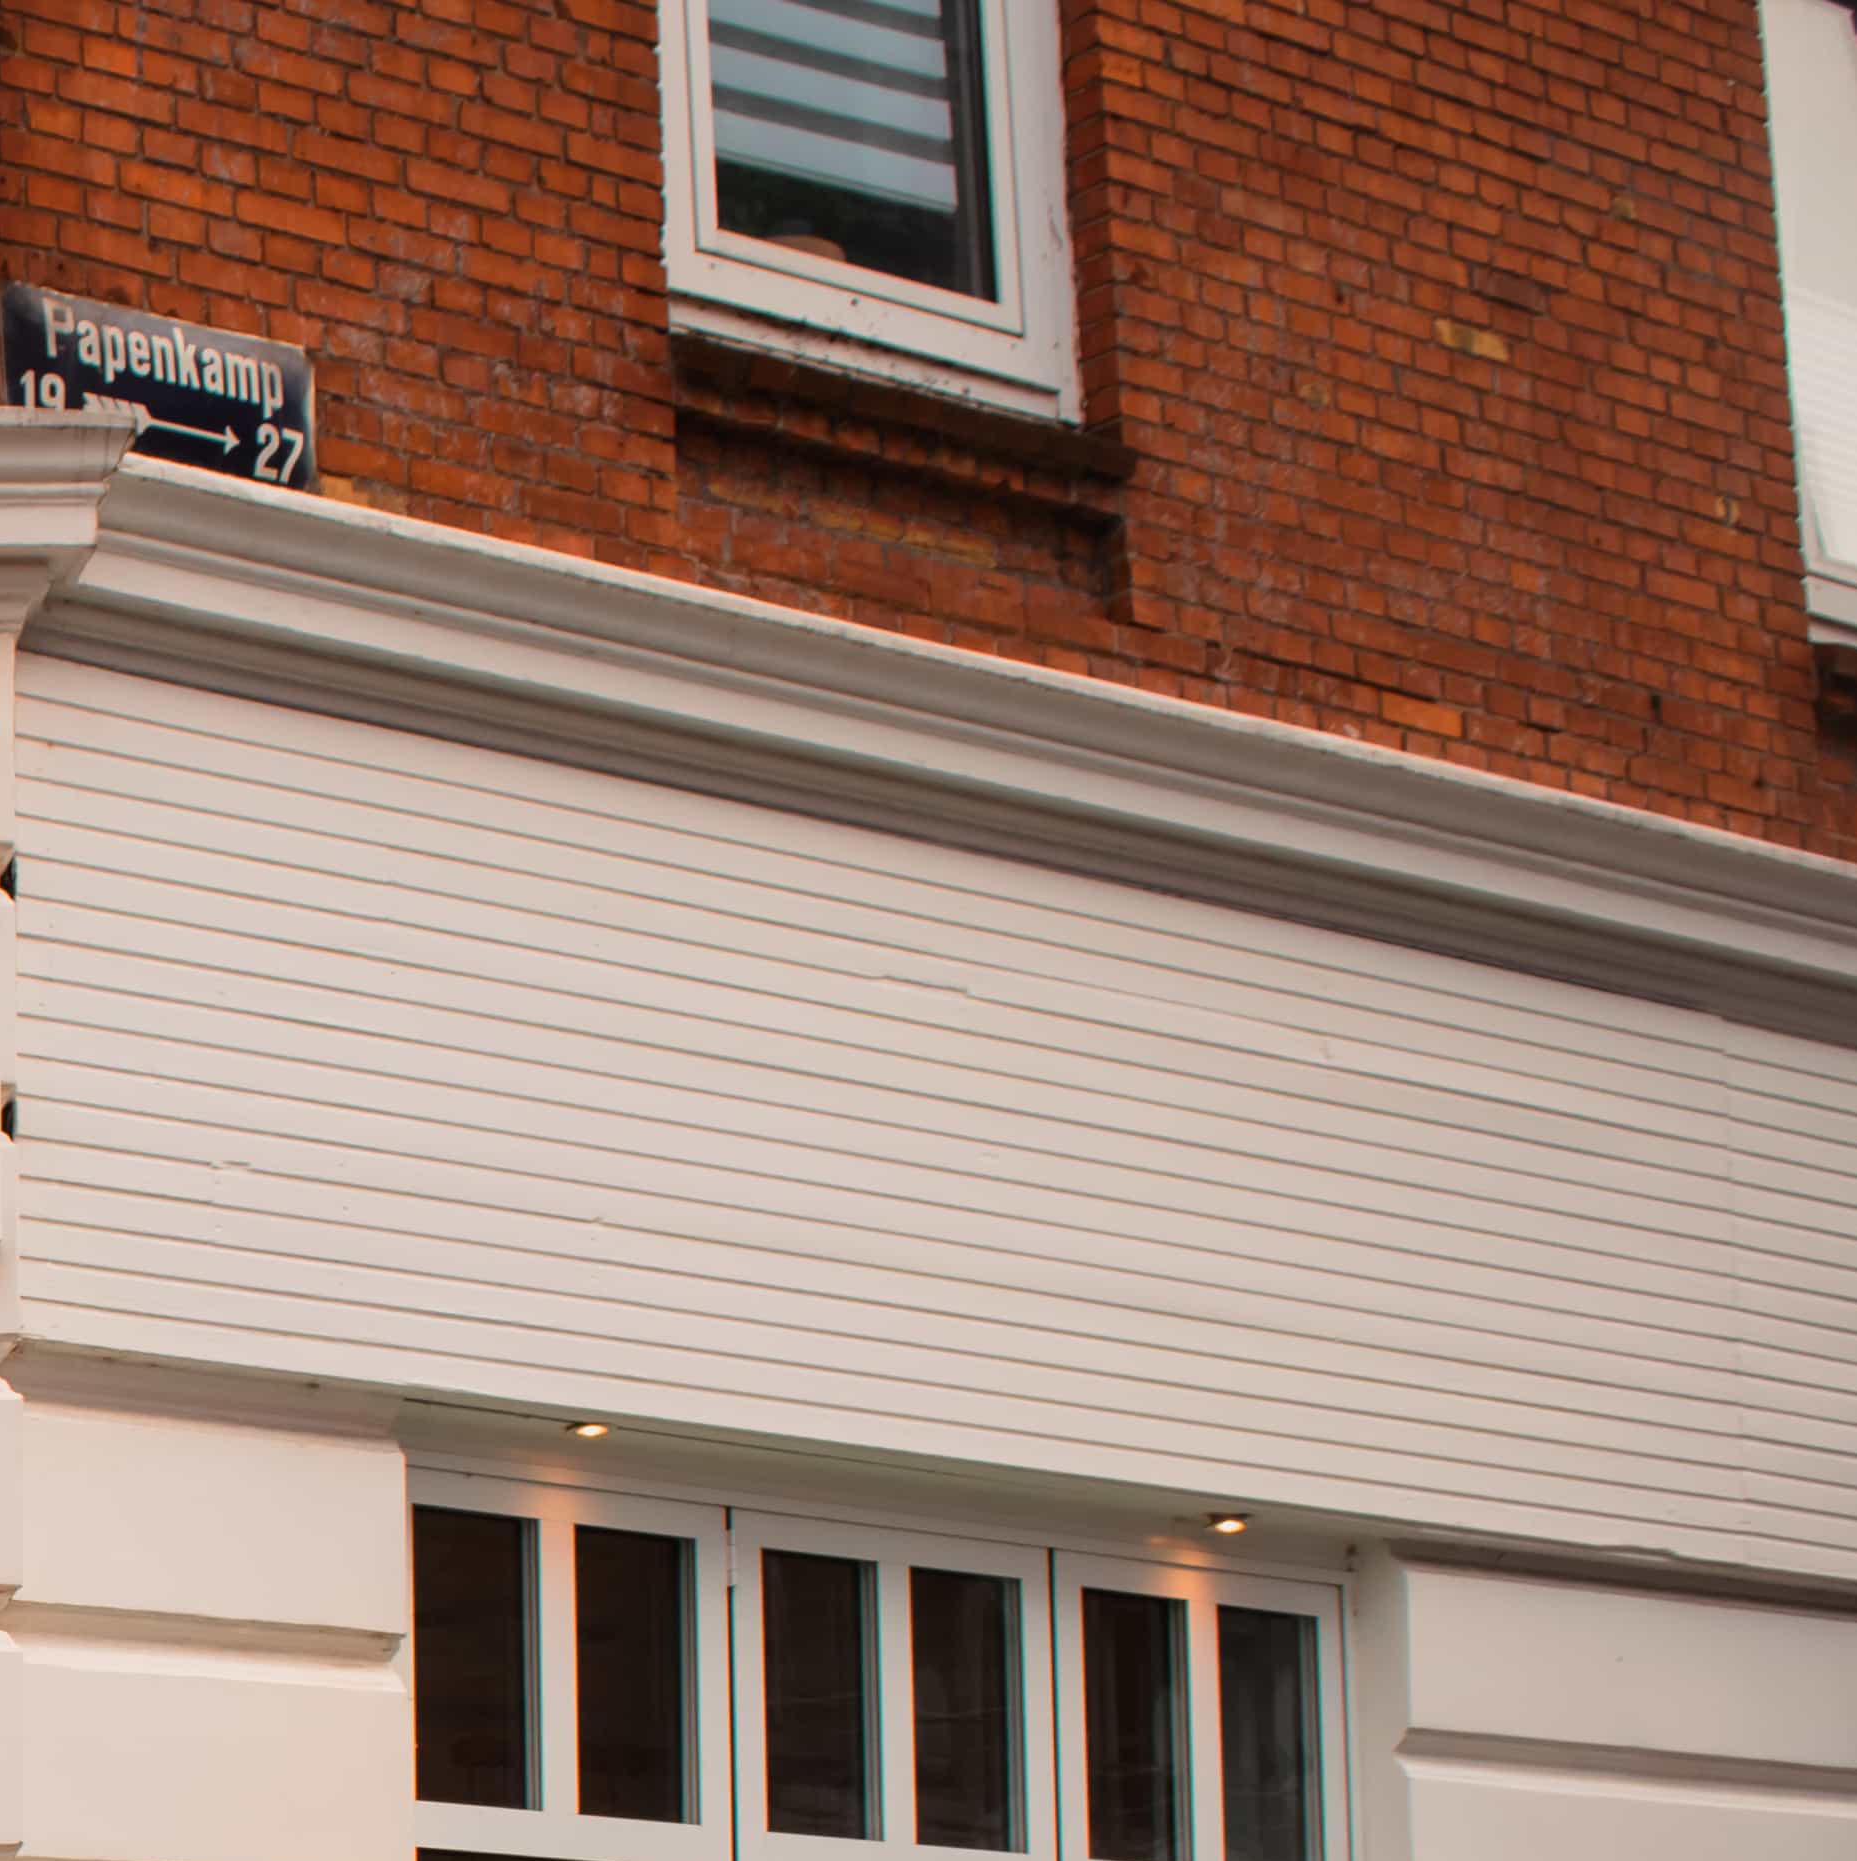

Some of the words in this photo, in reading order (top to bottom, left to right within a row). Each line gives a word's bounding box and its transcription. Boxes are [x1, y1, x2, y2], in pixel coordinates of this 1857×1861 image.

[42, 298, 285, 419] Papenkamp
[19, 369, 67, 411] 19
[253, 424, 303, 484] 27
